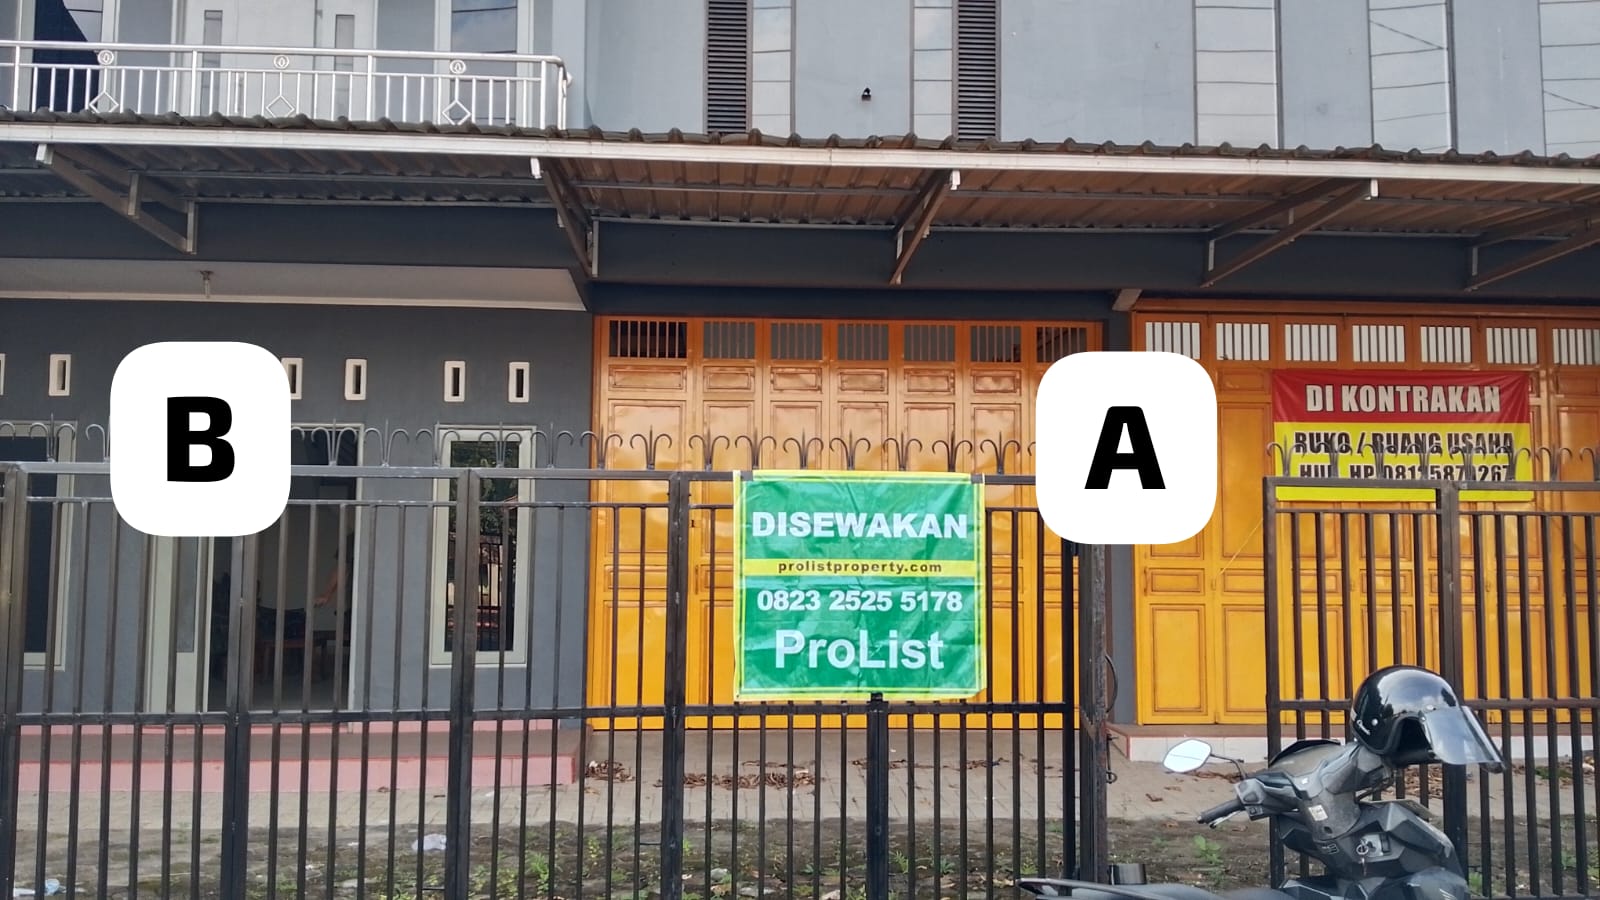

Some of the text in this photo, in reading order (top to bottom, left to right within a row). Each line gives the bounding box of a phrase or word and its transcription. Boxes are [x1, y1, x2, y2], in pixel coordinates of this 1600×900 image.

[1305, 384, 1501, 414] DI KONTRAKAN
[1294, 431, 1514, 455] RUKO / RUANG USAHA
[752, 511, 968, 539] DISEWAKAN
[778, 561, 942, 575] prolistproperty.com
[757, 590, 963, 612] 0823 2525 5178
[775, 629, 945, 669] ProList
